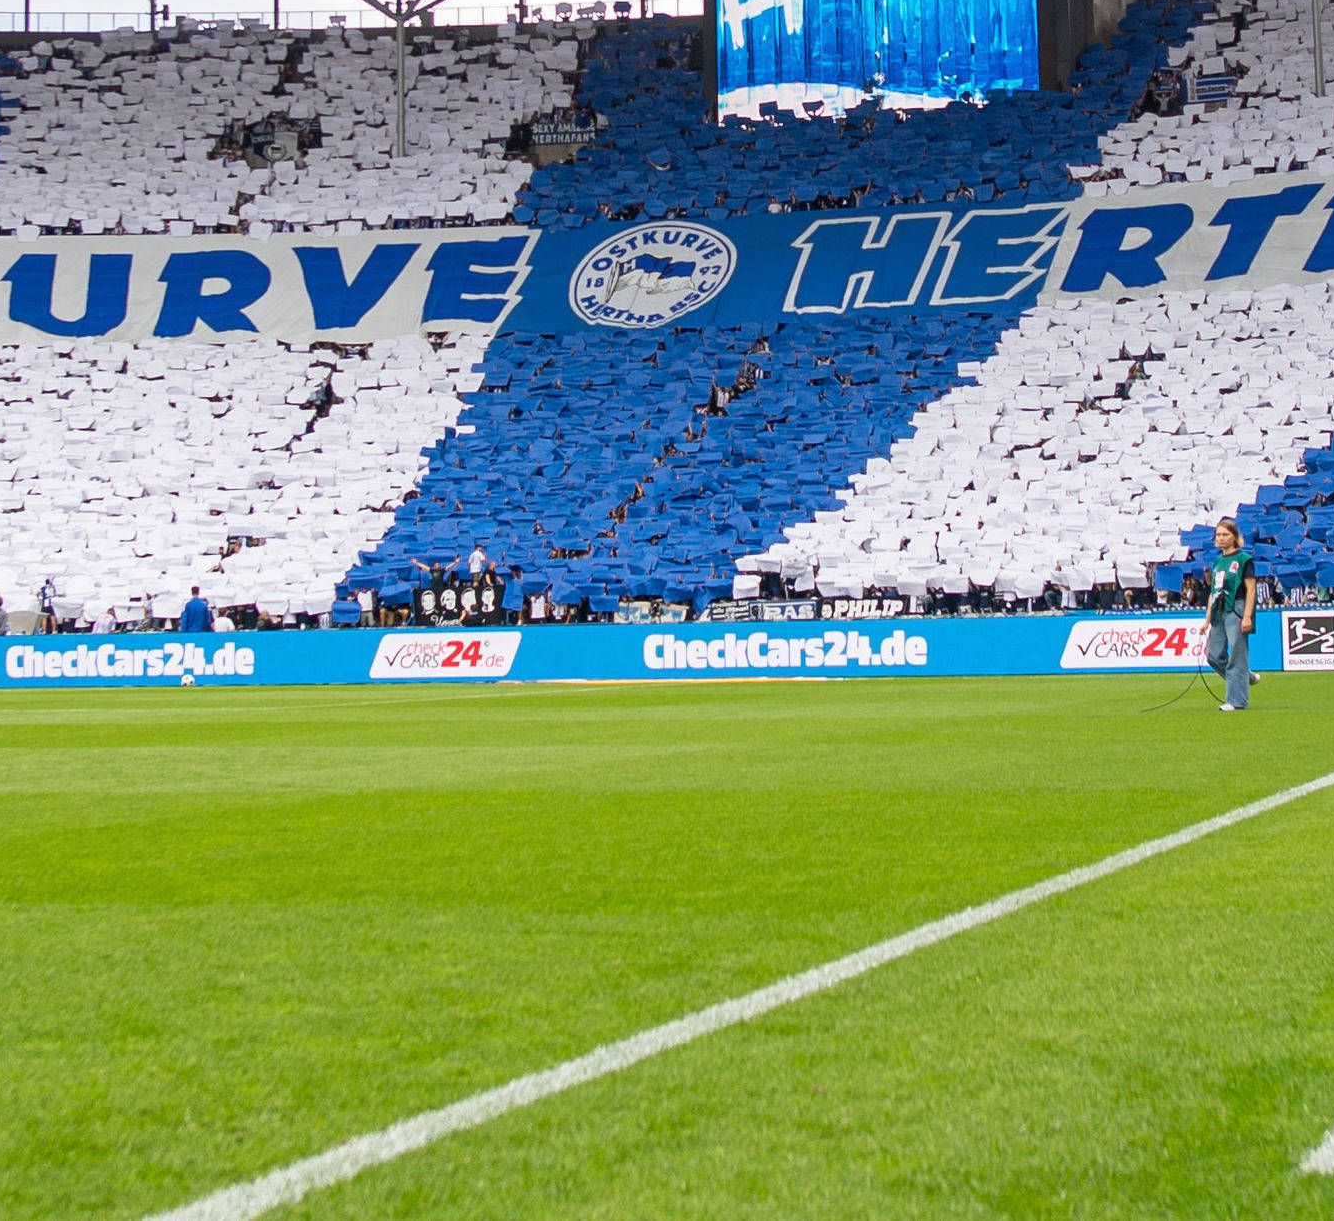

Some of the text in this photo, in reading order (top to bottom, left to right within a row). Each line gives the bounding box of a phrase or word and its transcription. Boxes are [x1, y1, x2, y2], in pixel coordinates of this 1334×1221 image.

[592, 231, 723, 272] OSTKURVE
[586, 277, 605, 288] 18
[833, 599, 905, 618] PHILIP
[643, 630, 928, 670] CheckCars24.de
[1094, 643, 1139, 658] CARS
[1142, 628, 1189, 657] 24
[1101, 627, 1147, 644] check
[5, 642, 255, 678] CheckCars24.de
[400, 654, 440, 669] CARS
[441, 640, 483, 668] 24
